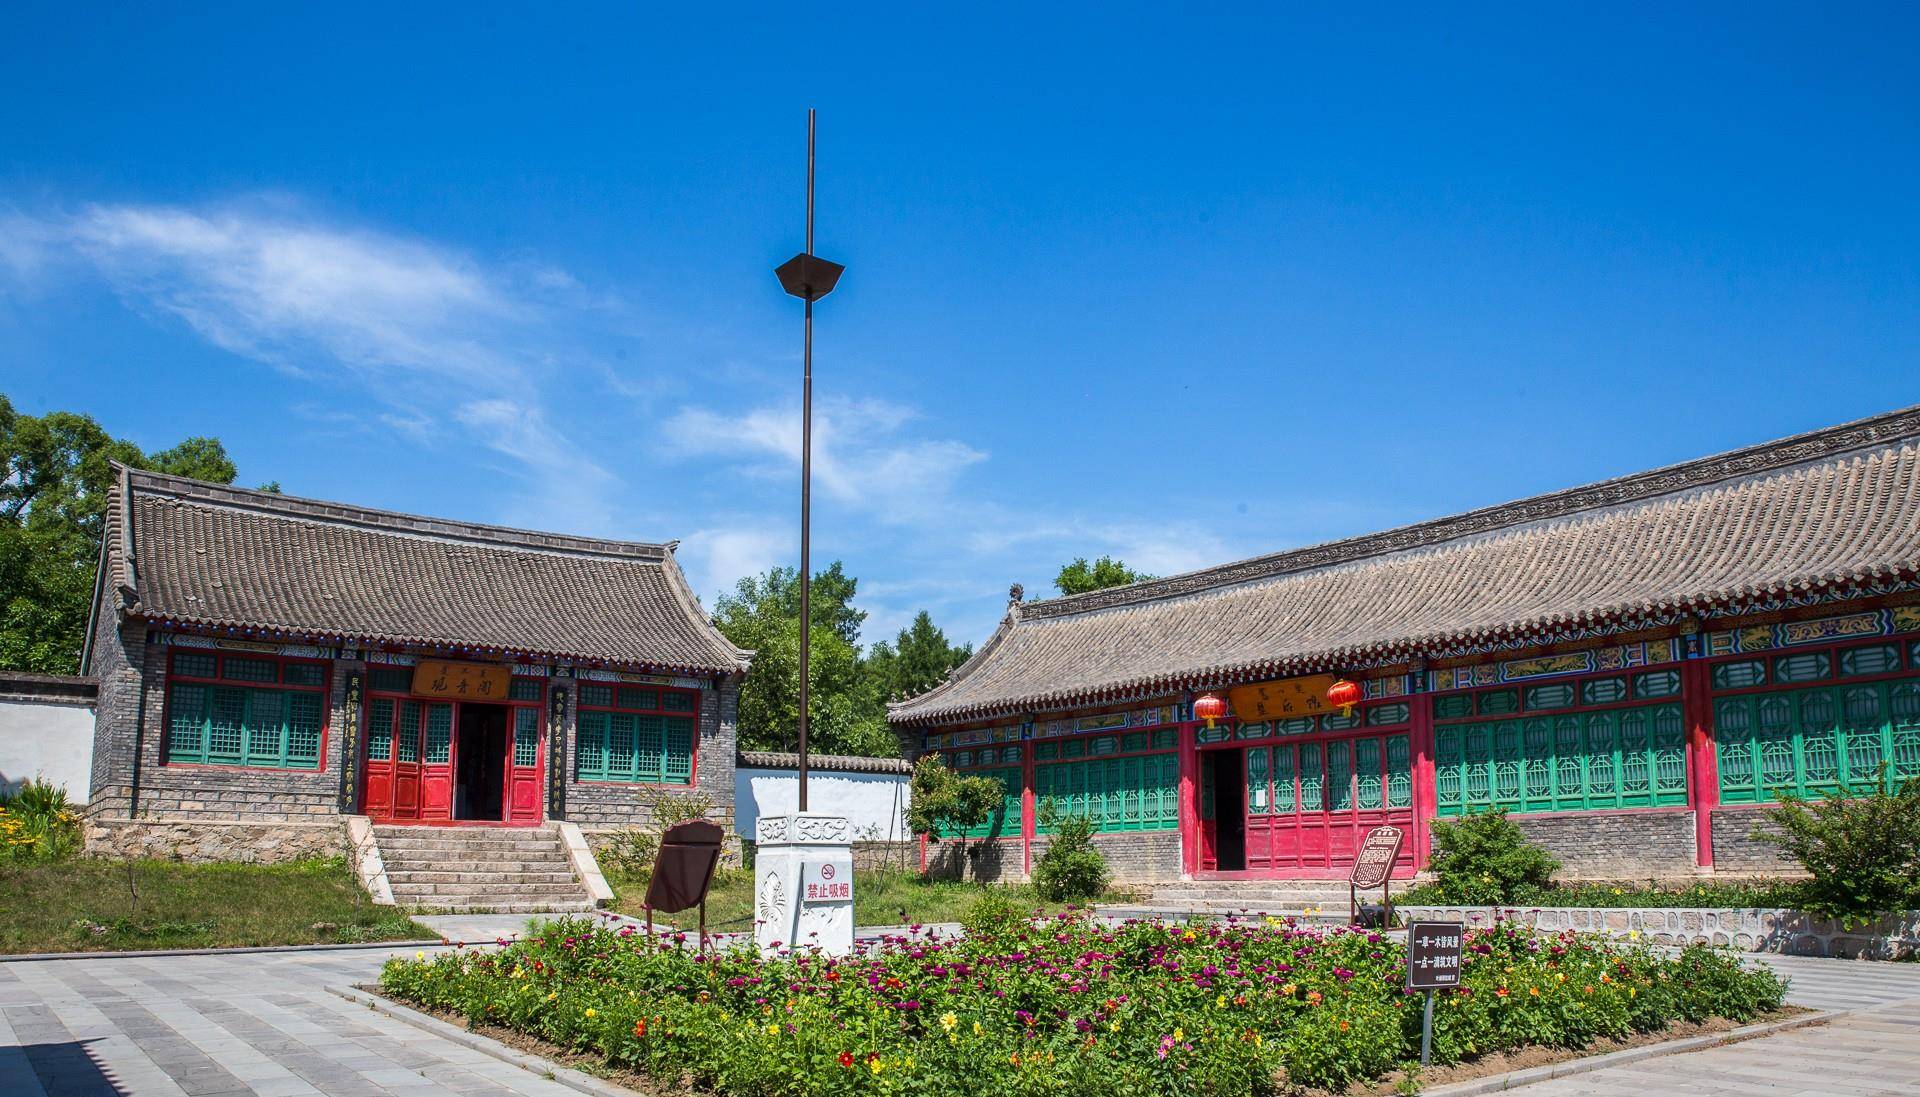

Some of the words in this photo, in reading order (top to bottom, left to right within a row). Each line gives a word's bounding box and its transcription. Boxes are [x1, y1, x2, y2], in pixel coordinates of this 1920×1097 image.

[807, 883, 849, 899] 禁止吸烟
[1415, 935, 1459, 949] 一草一木皆风景
